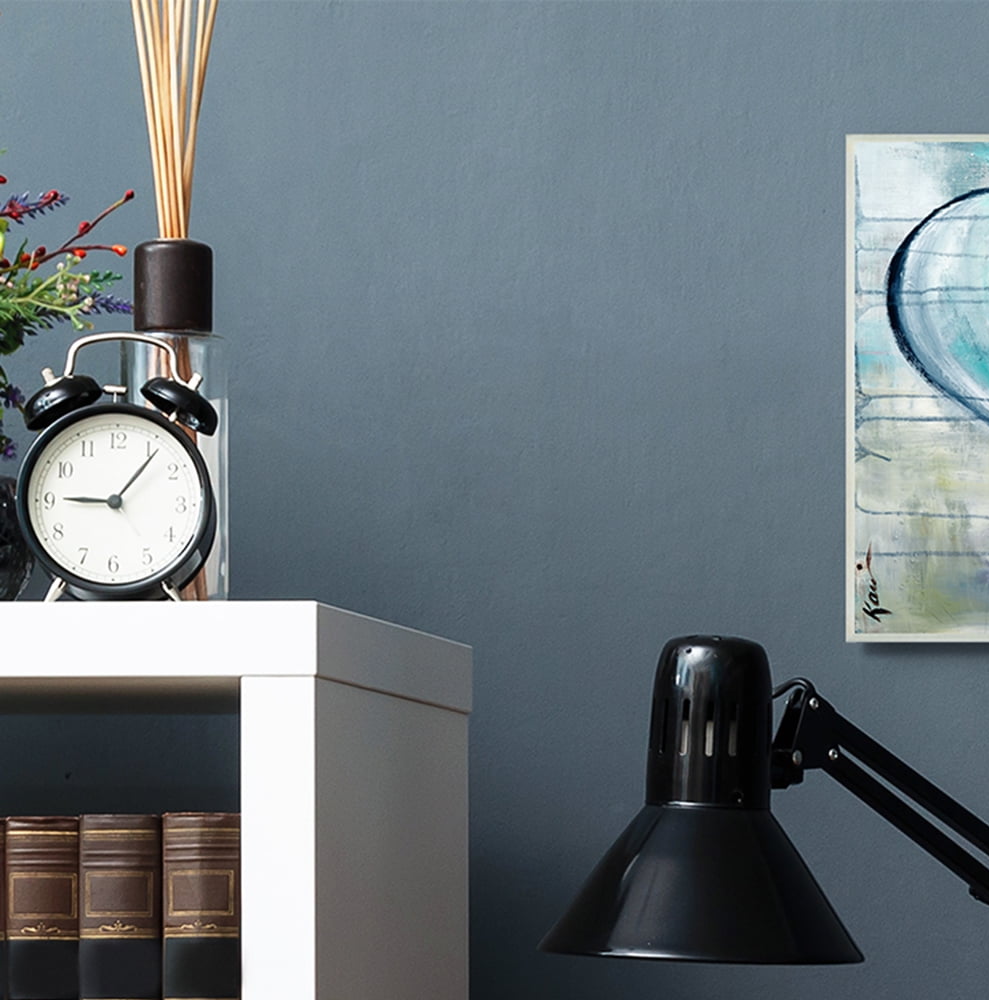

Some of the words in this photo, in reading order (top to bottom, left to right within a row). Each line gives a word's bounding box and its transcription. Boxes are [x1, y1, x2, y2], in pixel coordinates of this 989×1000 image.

[81, 440, 94, 457] 11
[109, 432, 127, 449] 12
[58, 461, 73, 479] 10
[167, 463, 179, 480] 2
[44, 492, 55, 510] 9
[175, 496, 187, 513] 3
[53, 523, 64, 540] 8
[164, 526, 176, 542] 4
[78, 547, 89, 565] 7
[108, 555, 120, 573] 6
[142, 548, 153, 565] 5
